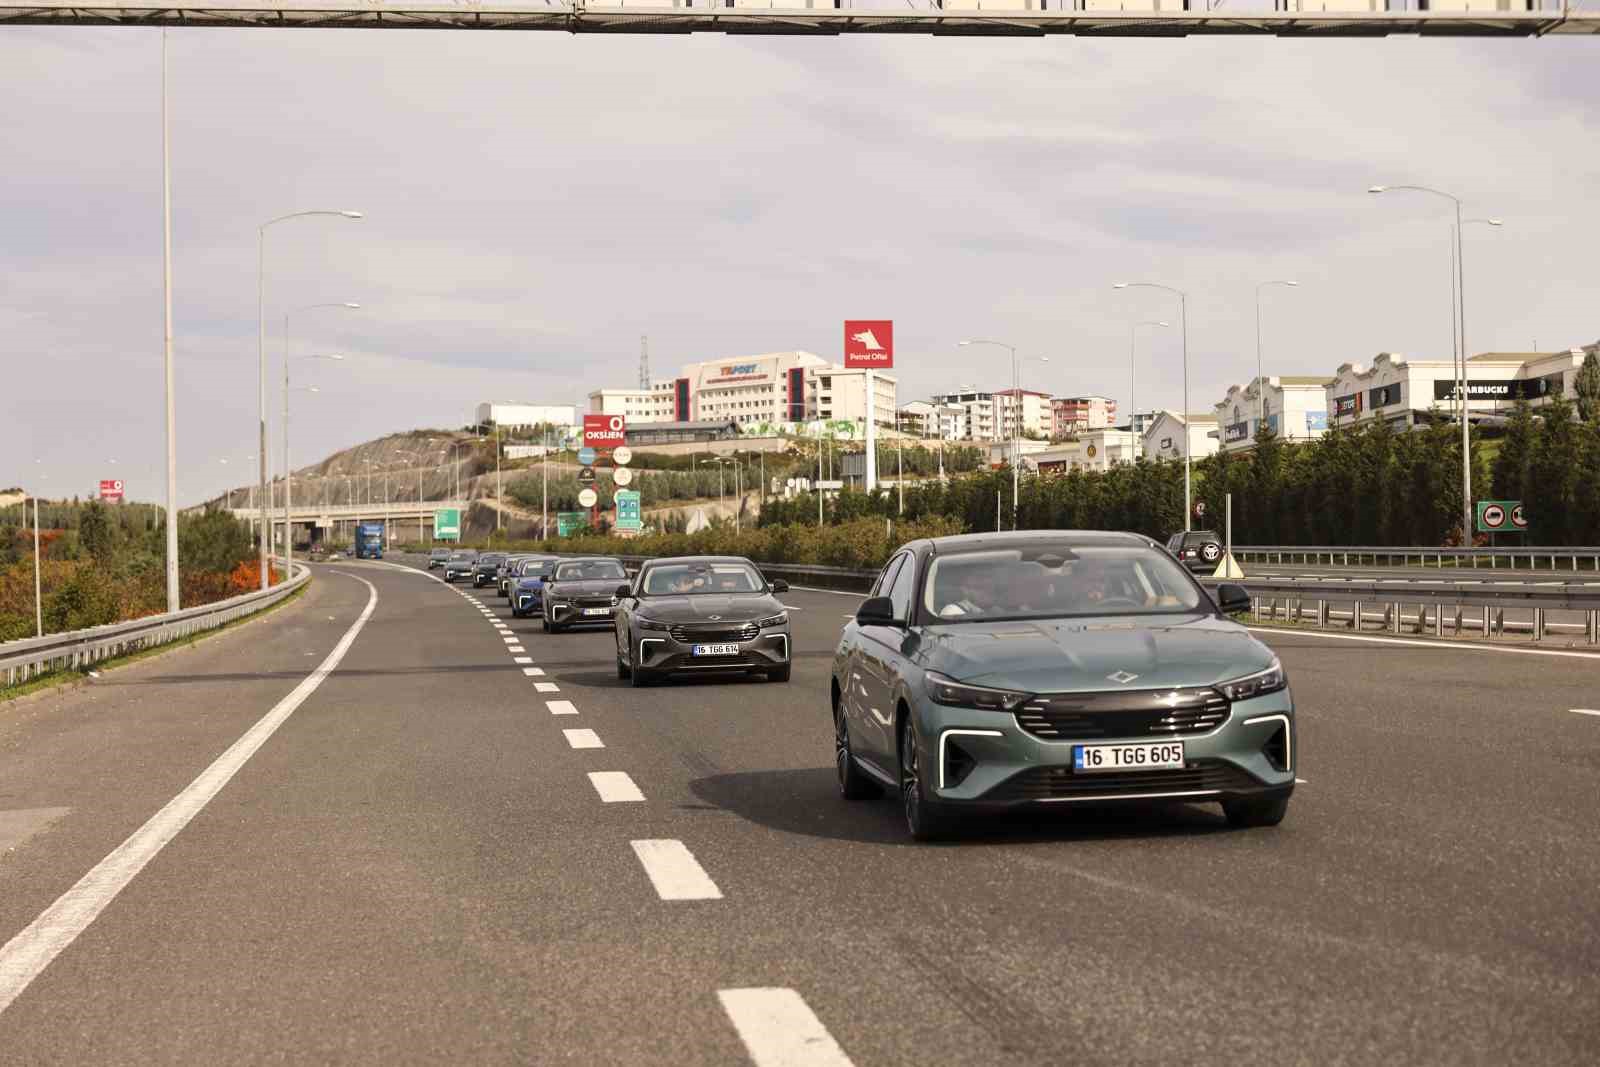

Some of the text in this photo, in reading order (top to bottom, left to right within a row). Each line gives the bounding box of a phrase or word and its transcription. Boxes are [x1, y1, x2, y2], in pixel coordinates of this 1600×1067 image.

[850, 352, 870, 361] Petrol
[697, 646, 706, 654] 16
[709, 645, 724, 654] TGG
[1085, 749, 1102, 766] 16
[1112, 747, 1145, 765] TGG
[1151, 746, 1181, 762] 605
